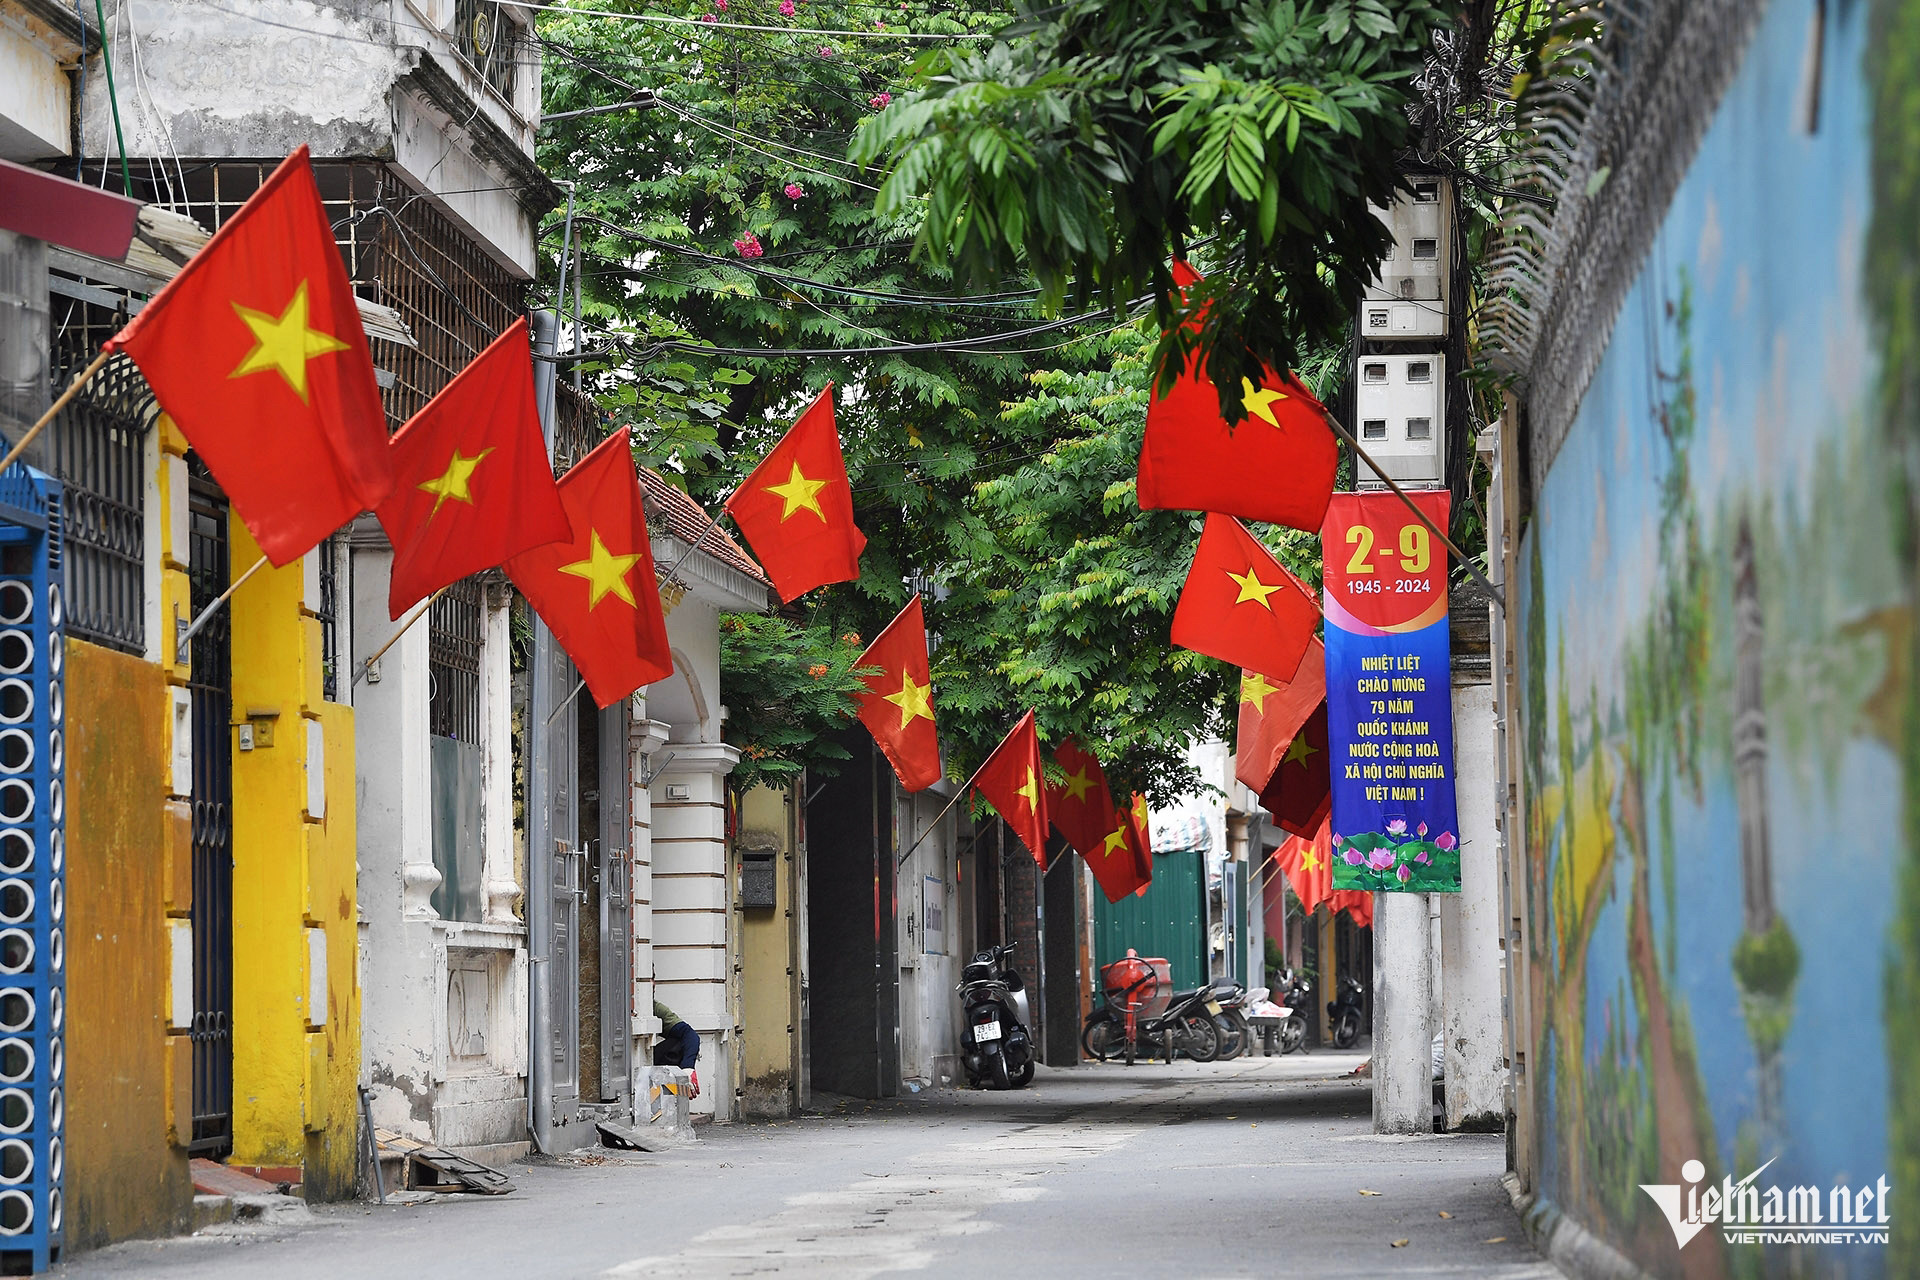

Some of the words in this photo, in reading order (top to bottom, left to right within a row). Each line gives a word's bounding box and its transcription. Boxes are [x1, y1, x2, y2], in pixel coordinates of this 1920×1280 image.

[1347, 580, 1381, 594] 1945
[1395, 579, 1431, 593] 2024
[1361, 654, 1394, 674] NHIỆT
[1397, 653, 1420, 673] LIỆT
[1357, 675, 1389, 693] CHÀO
[1391, 675, 1426, 692] MỪNG
[1370, 700, 1385, 714] 79
[1388, 697, 1414, 714] NĂM
[1357, 717, 1388, 737] QUỐC
[1391, 719, 1429, 736] KHÁNH
[1349, 741, 1380, 757] NƯỚC
[1382, 740, 1413, 760] CỘNG
[1415, 740, 1440, 757] HOÀ
[1344, 762, 1361, 779] XÃ
[1363, 762, 1382, 782] HỘI
[1384, 761, 1407, 779] CHỦ
[1408, 762, 1445, 779] NGHĨA
[1365, 784, 1389, 804] VIỆT
[1391, 786, 1417, 801] NAM
